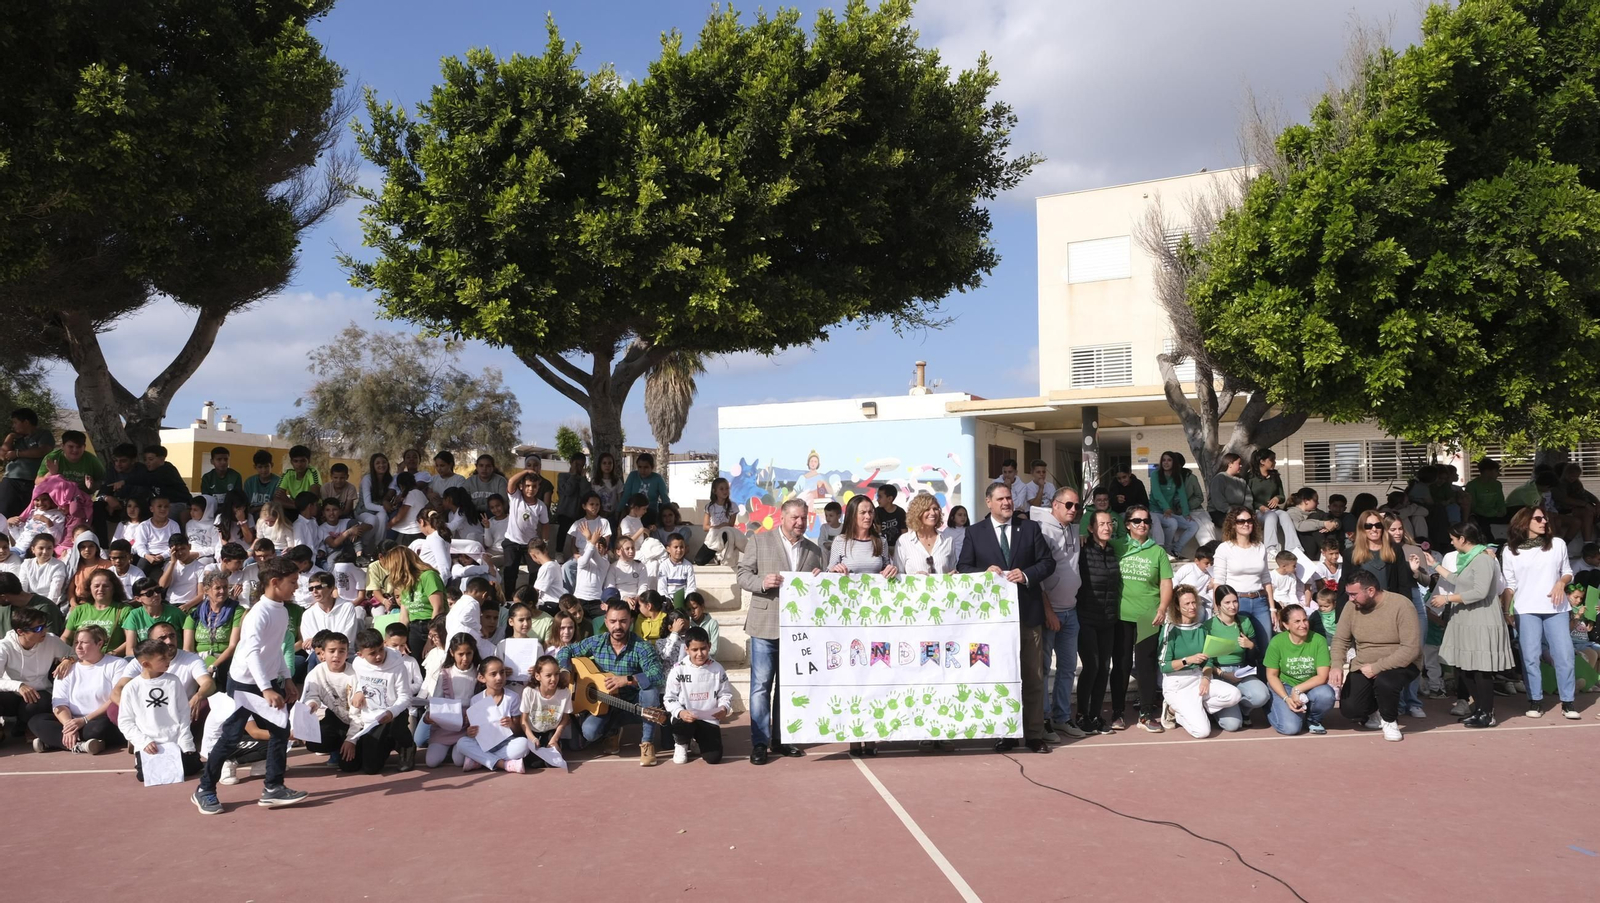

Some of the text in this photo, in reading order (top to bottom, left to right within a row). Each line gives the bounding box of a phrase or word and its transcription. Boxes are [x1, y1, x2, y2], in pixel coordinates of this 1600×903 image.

[792, 632, 808, 641] DIA
[801, 647, 812, 656] DE
[826, 638, 990, 671] BANDERA
[795, 661, 818, 675] LA
